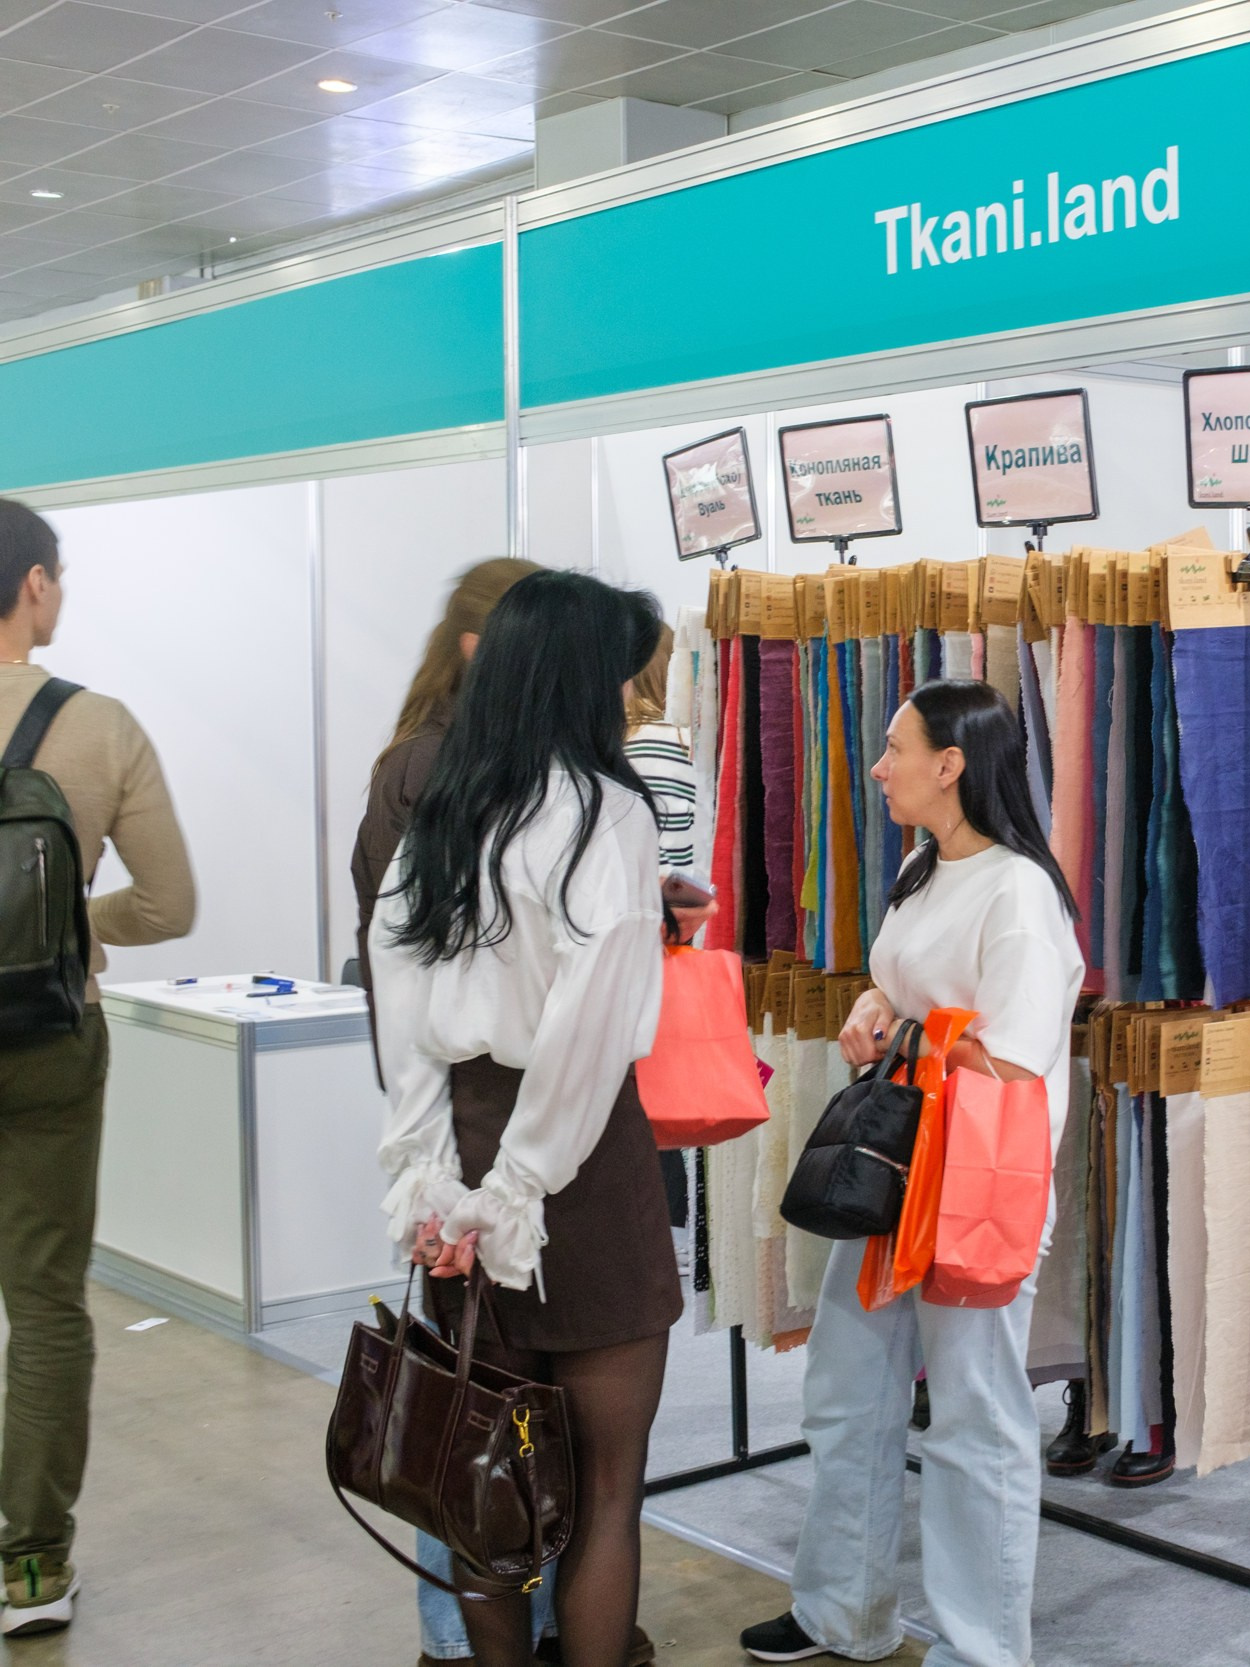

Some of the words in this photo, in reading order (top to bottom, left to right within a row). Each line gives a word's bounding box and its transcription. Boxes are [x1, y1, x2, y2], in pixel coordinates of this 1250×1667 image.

[874, 145, 1180, 275] Tkani.land
[788, 454, 882, 477] Конопляная
[984, 443, 1083, 476] Крапива
[697, 500, 726, 518] Вуаль
[815, 489, 863, 507] ткань
